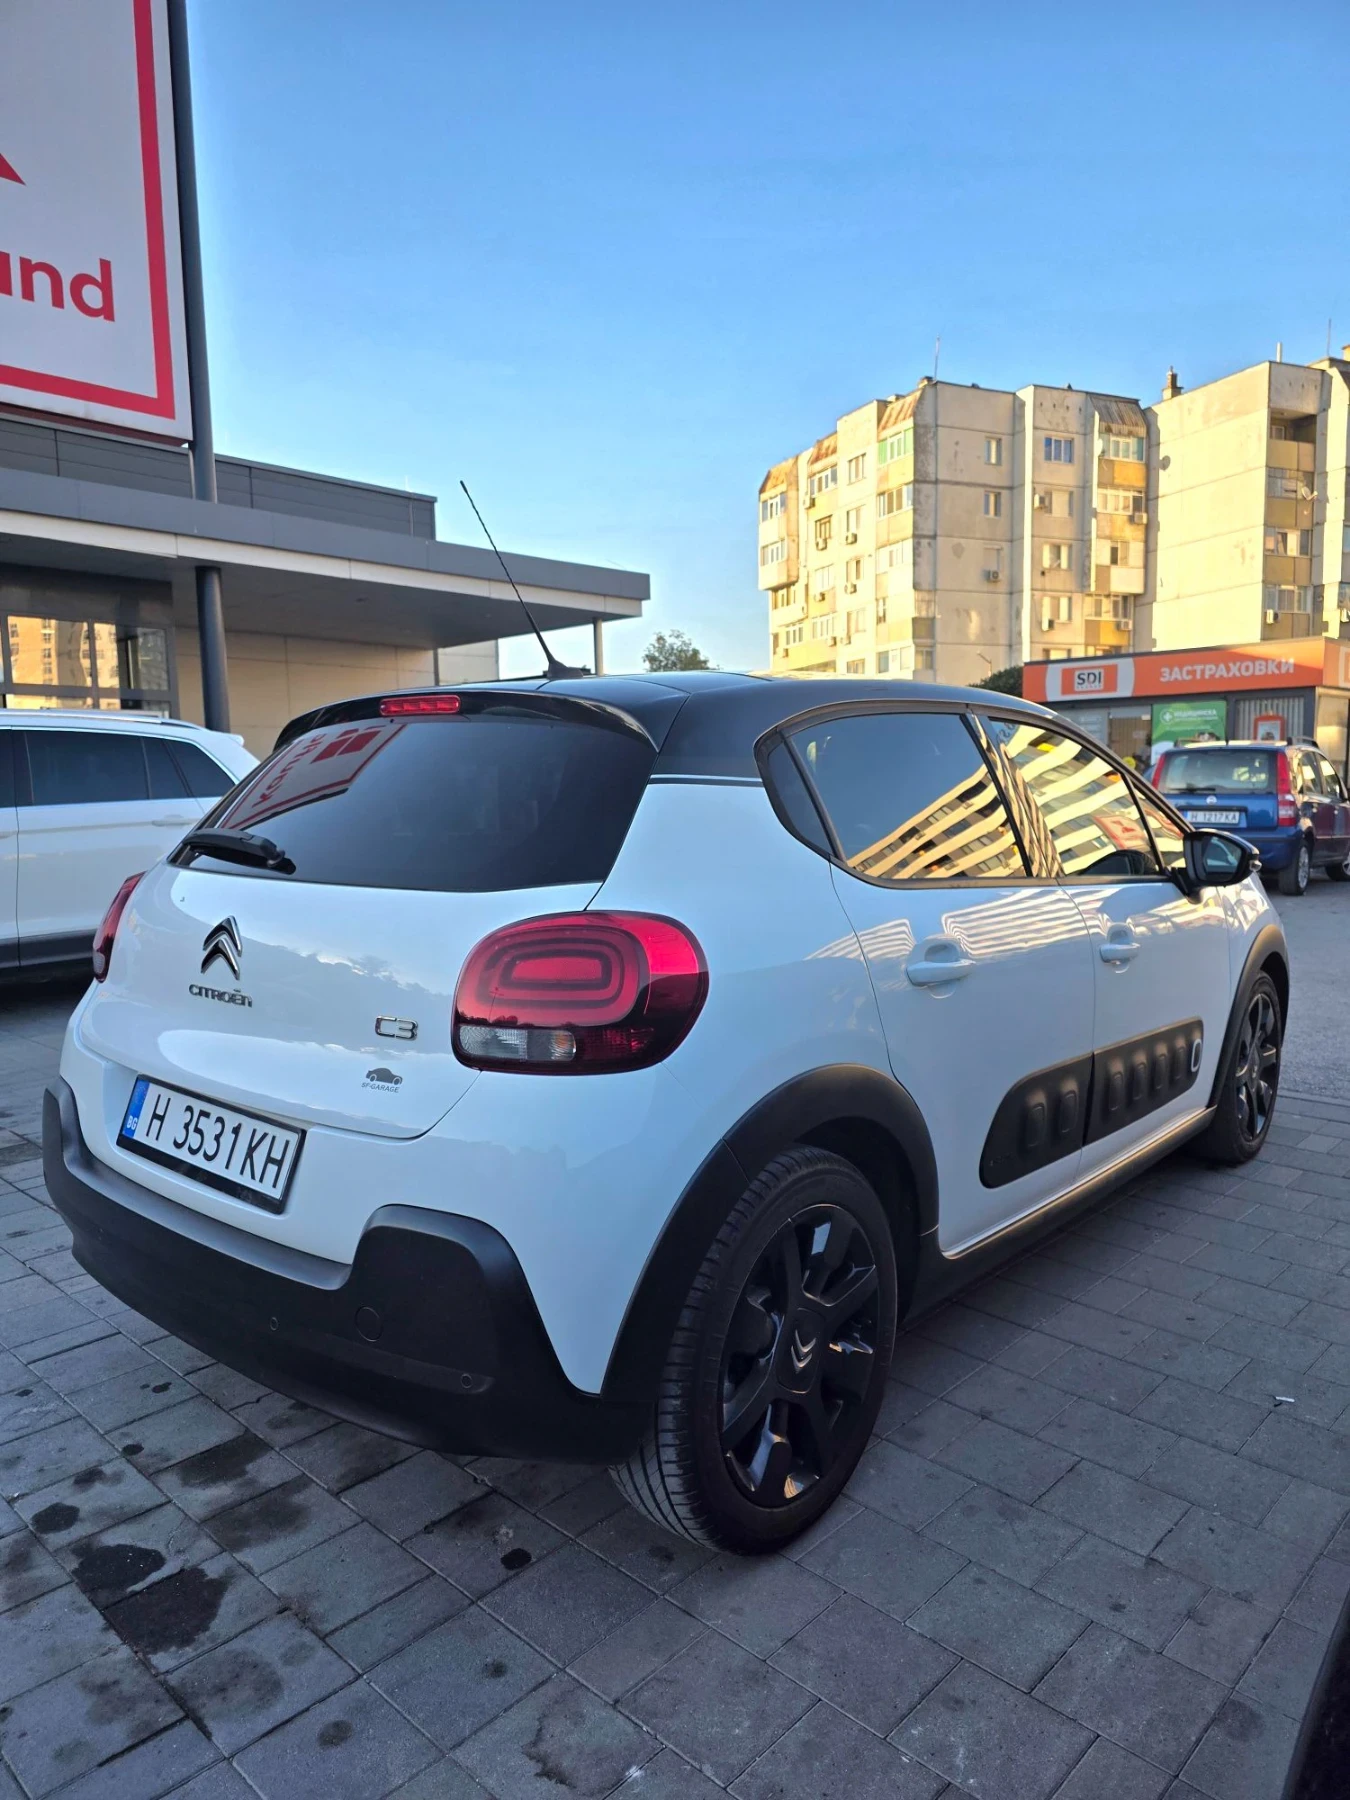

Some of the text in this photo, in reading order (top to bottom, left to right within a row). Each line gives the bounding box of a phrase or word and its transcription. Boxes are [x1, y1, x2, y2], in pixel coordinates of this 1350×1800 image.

[1077, 671, 1102, 685] SDI
[1160, 659, 1294, 682] ЗАСТРАХОВКИ
[375, 1015, 418, 1040] C3
[126, 1115, 138, 1131] BG
